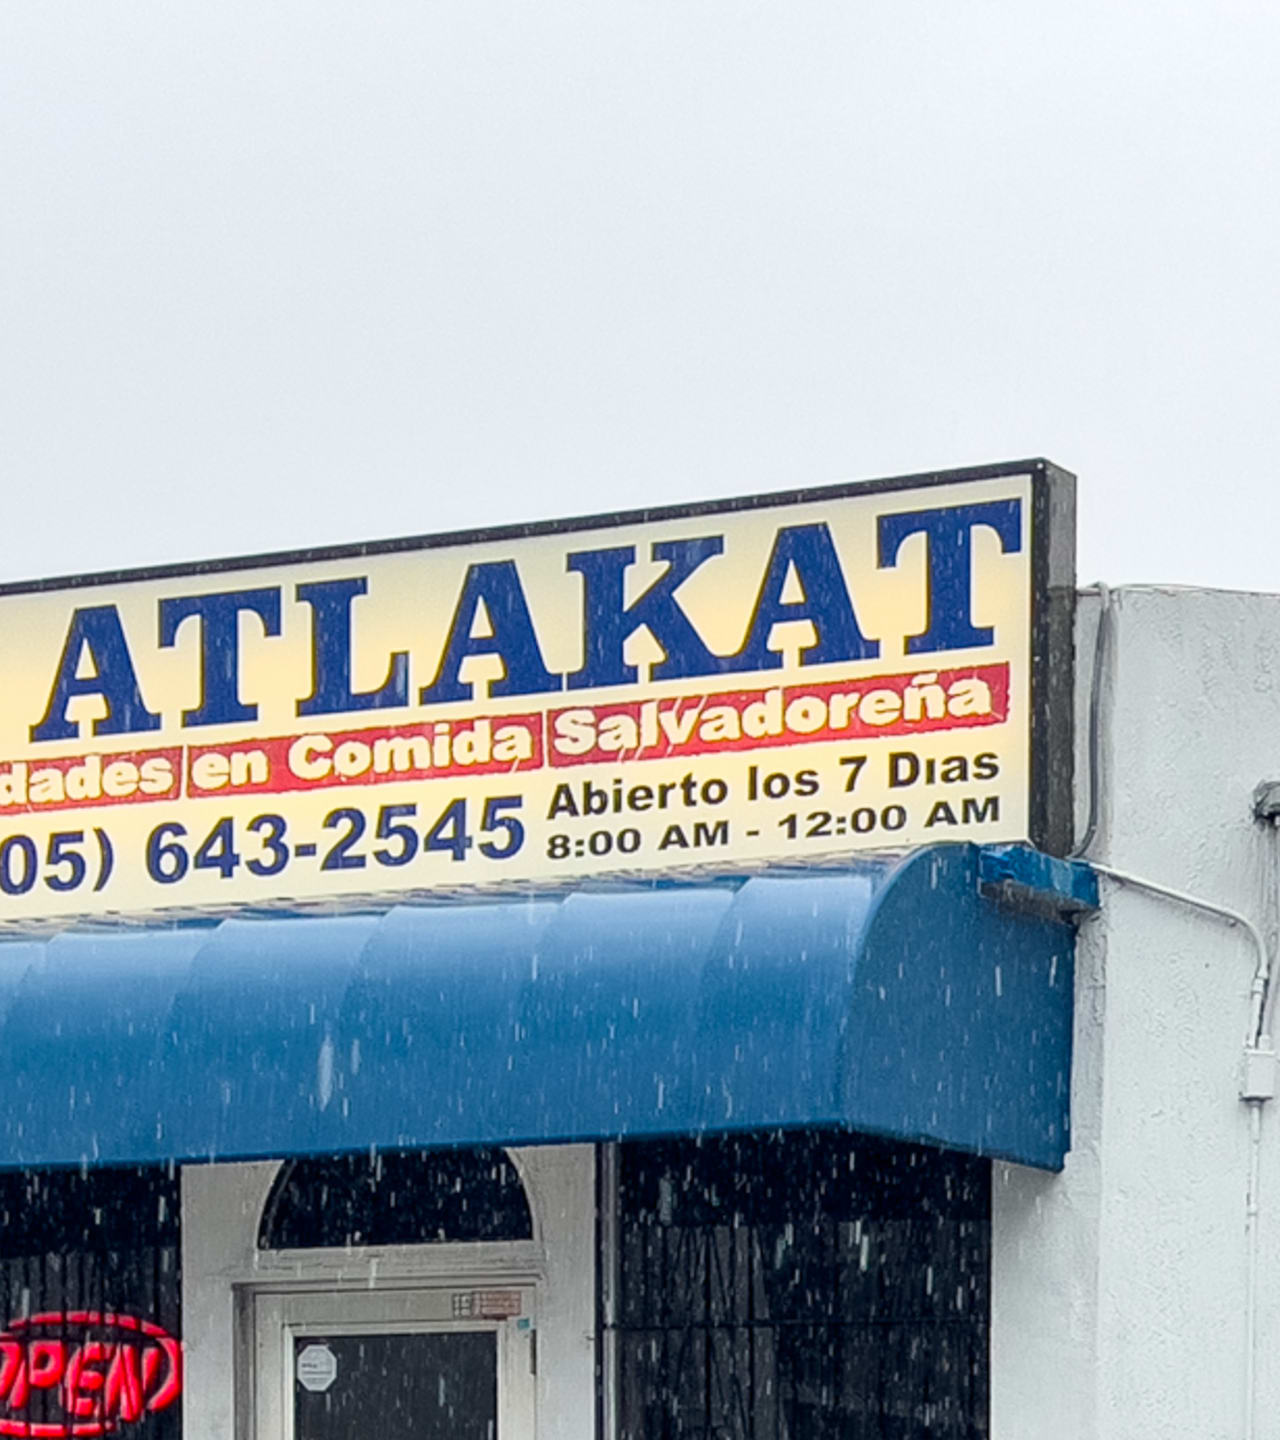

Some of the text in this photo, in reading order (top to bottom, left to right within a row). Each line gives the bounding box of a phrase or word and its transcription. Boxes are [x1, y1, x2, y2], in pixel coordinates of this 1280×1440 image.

[28, 498, 1023, 743] ATLAKAT
[190, 749, 269, 791] en
[286, 721, 535, 781] Comida
[552, 672, 992, 757] Salvadoreña
[547, 774, 728, 820] Abierto
[748, 766, 820, 801] los
[839, 754, 868, 792] 7
[547, 827, 642, 860] 8:00
[658, 819, 729, 850] AM
[778, 804, 906, 839] 12:00
[923, 796, 1000, 829] AM
[146, 796, 526, 885] 643-2545
